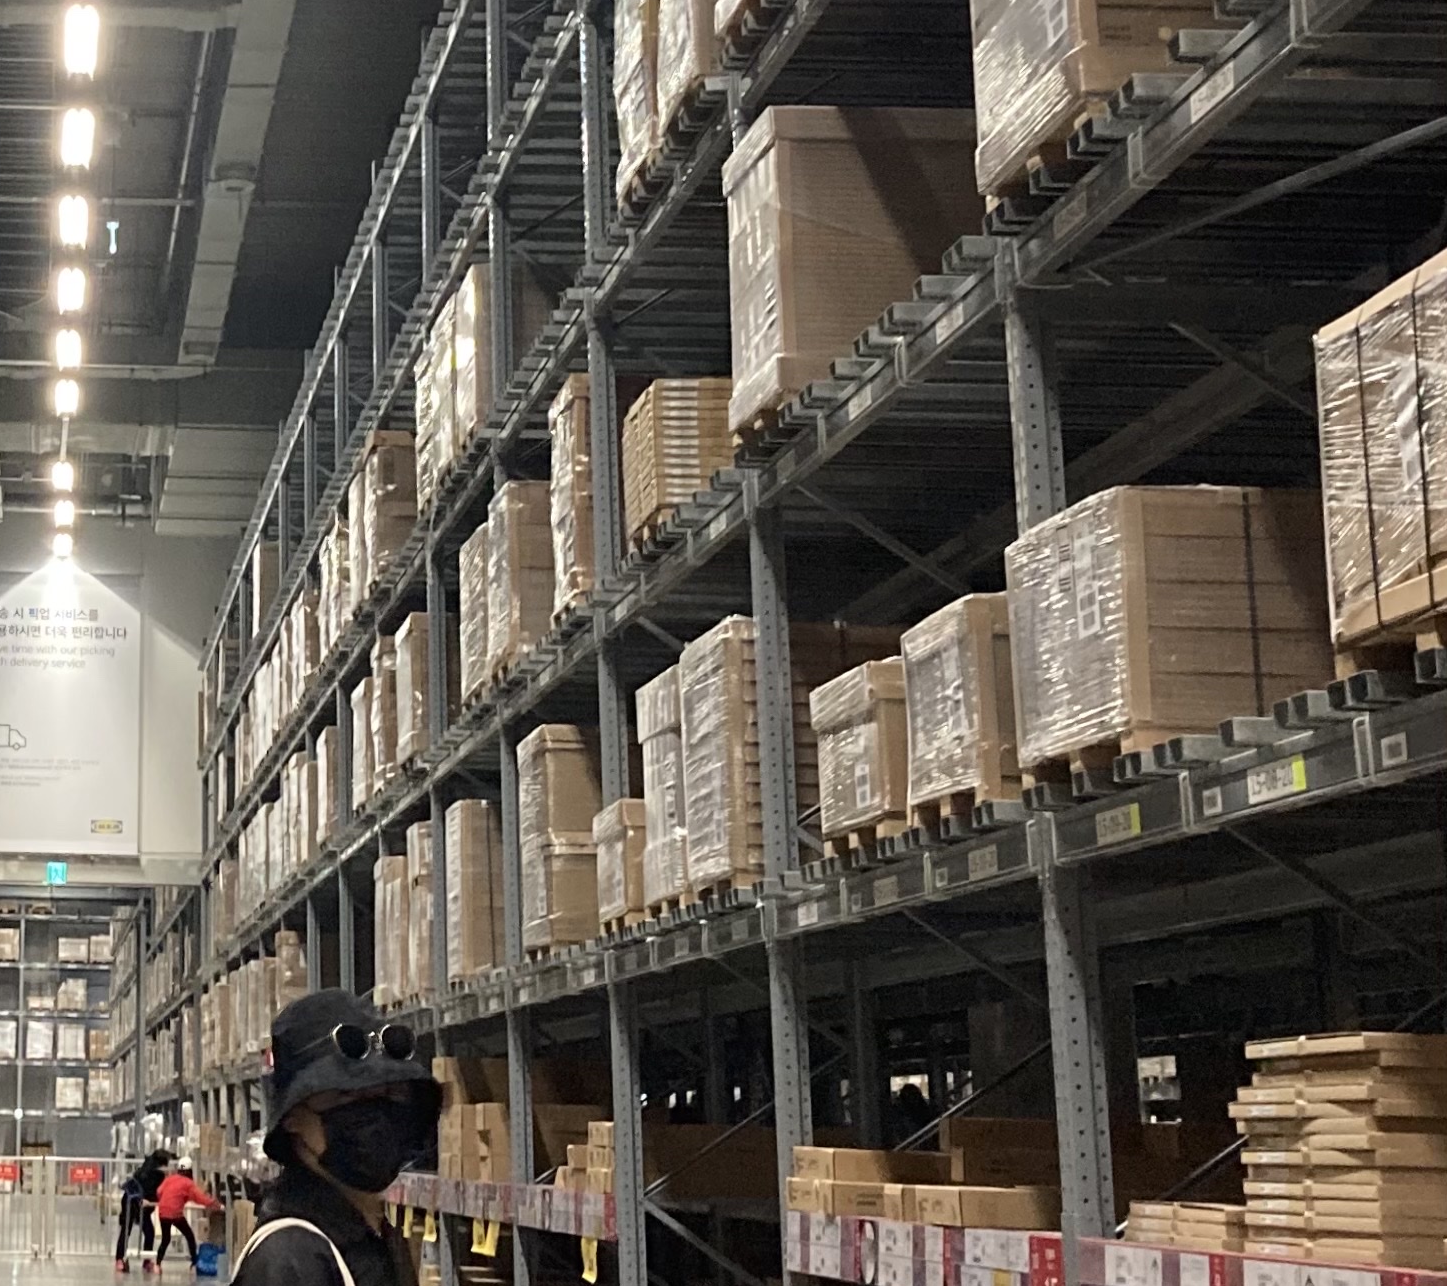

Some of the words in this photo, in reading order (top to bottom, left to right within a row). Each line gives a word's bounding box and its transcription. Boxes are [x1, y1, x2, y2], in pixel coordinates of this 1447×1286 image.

[13, 607, 24, 620] 시
[28, 607, 51, 621] 픽업
[55, 608, 99, 622] 서비스를
[44, 625, 68, 639] 더욱
[72, 626, 128, 640] 편리합니다
[11, 644, 34, 654] time
[36, 644, 58, 654] with
[60, 646, 77, 655] our
[79, 645, 116, 658] picking
[9, 658, 49, 670] delivery
[51, 659, 86, 669] service
